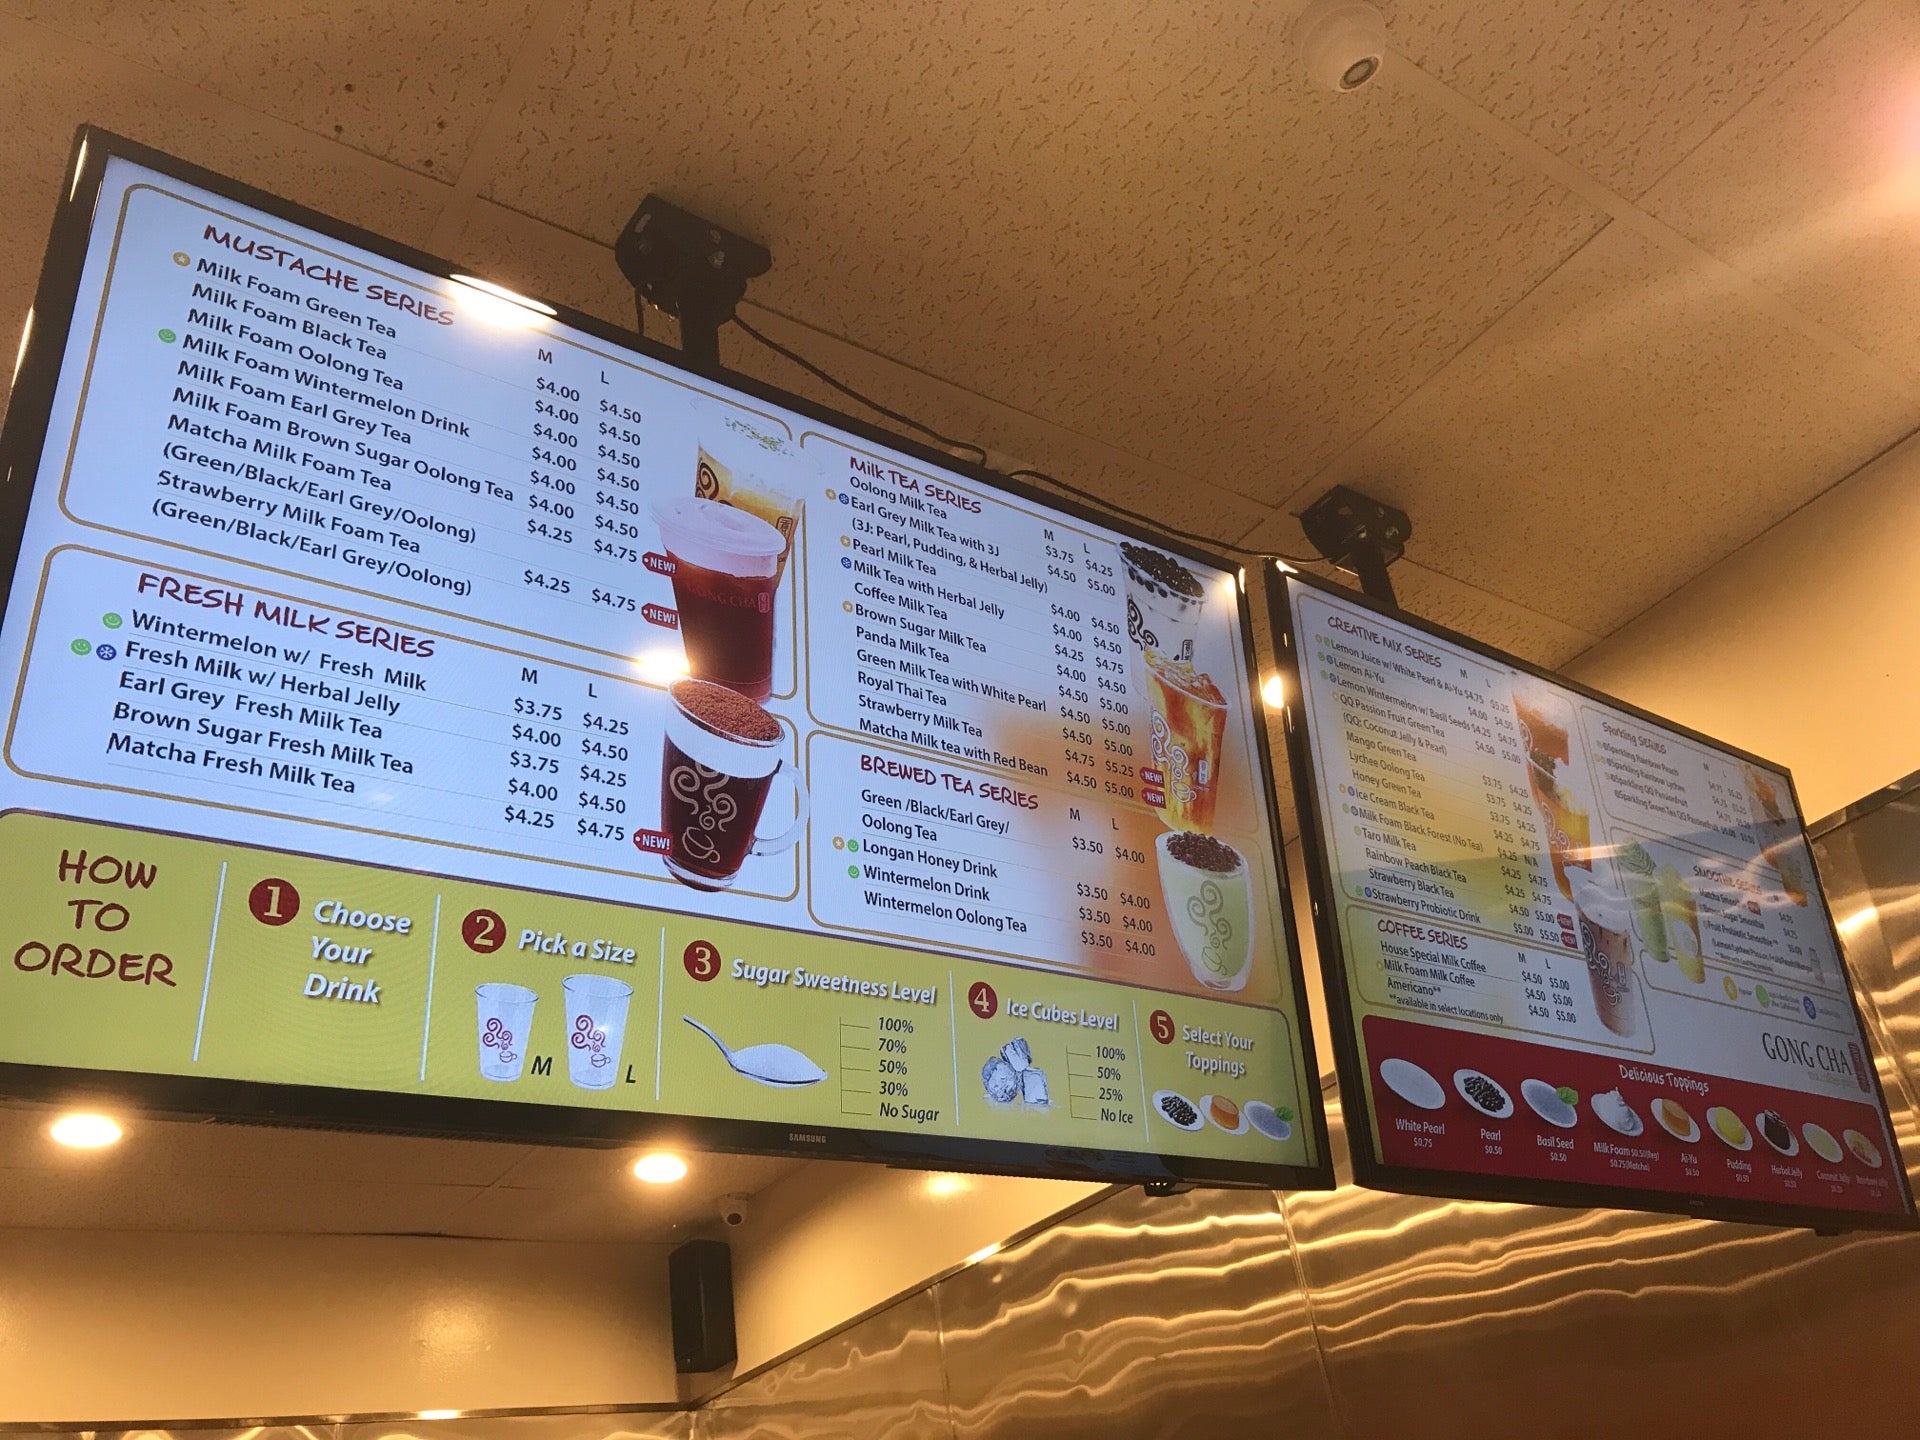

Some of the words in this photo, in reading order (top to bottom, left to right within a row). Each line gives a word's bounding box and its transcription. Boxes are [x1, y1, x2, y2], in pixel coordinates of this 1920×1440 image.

[202, 223, 360, 294] MUSTACHE
[364, 284, 454, 326] SERIES
[195, 256, 243, 286] Milk
[245, 273, 301, 306] Foam
[304, 296, 362, 328] Green
[365, 314, 397, 339] Tea
[536, 347, 553, 365] M
[599, 369, 610, 386] L
[181, 333, 230, 362] Milk
[233, 348, 290, 381] Foam
[293, 367, 417, 421] Wintermelon
[420, 409, 470, 438] Drink
[535, 375, 581, 403] $4.00
[598, 398, 642, 425] $4.50
[171, 385, 221, 414] Milk
[224, 400, 282, 432] Foam
[286, 419, 350, 453] Brown
[353, 440, 411, 470] Sugar
[412, 459, 481, 495] Oolong
[483, 479, 514, 502] Tea
[162, 441, 345, 506] (Green/Black/Earl
[348, 493, 477, 544] Grey/Oolong)
[848, 475, 897, 505] Oolong
[898, 491, 926, 513] Milk
[925, 501, 948, 520] Tea
[849, 455, 886, 482] Milk
[886, 468, 921, 495] TEA
[923, 483, 982, 515] SERIES
[850, 494, 876, 516] Earl
[876, 505, 907, 528] Grey
[908, 515, 936, 536] Milk
[934, 524, 958, 544] Tea
[958, 534, 986, 553] with
[986, 542, 1000, 558] 3J
[649, 556, 677, 574] NEW!
[851, 516, 875, 536] (3J:
[875, 524, 911, 549] Pearl,
[911, 536, 967, 568] Pudding,
[967, 555, 979, 571] &
[978, 559, 1018, 583] Herbal
[1018, 573, 1049, 594] Jelly)
[1044, 543, 1075, 565] $3.75
[1084, 557, 1114, 578] $4.25
[136, 571, 245, 617] FRESH
[252, 599, 331, 636] MILK
[334, 619, 436, 658] SERIES
[131, 608, 277, 659] Wintermelon
[282, 647, 311, 666] w/
[318, 652, 374, 681] Fresh
[383, 667, 427, 692] Milk
[1326, 615, 1382, 646] CREATIVE
[1381, 635, 1404, 655] MIX
[1403, 643, 1443, 669] SERIES
[520, 666, 538, 685] M
[587, 681, 598, 699] L
[513, 695, 563, 722] $3.75
[581, 711, 630, 736] $4.25
[859, 753, 938, 786] BREWED
[939, 772, 975, 797] TEA
[978, 781, 1039, 811] SERIES
[1143, 769, 1164, 784] NEW!
[503, 803, 555, 829] $4.25
[576, 817, 625, 842] $4.75
[860, 788, 903, 811] Green
[974, 813, 1010, 836] Grey/
[641, 833, 671, 851] NEW!
[1360, 825, 1382, 843] Taro
[1381, 831, 1403, 849] Milk
[1399, 836, 1418, 852] Tea
[57, 848, 158, 890] HOW
[862, 837, 915, 862] Longan
[916, 848, 961, 874] Honey
[961, 857, 998, 879] Drink
[1367, 866, 1417, 893] Strawberry
[1415, 878, 1441, 896] Black
[1437, 884, 1455, 899] Tea
[66, 898, 131, 933] TO
[263, 884, 283, 918] 1
[306, 899, 412, 934] Choose
[862, 889, 954, 920] Wintermelon
[954, 906, 1004, 933] Oolong
[1004, 915, 1028, 933] Tea
[1370, 886, 1421, 913] Strawberry
[1419, 898, 1459, 919] Probiotic
[1457, 907, 1482, 924] Drink
[472, 914, 495, 947] 2
[514, 927, 569, 955] Pick
[569, 940, 588, 958] a
[588, 938, 636, 964] Size
[1080, 928, 1114, 950] $3.50
[1124, 938, 1156, 957] $4.00
[1376, 918, 1427, 942] COFFEE
[1426, 927, 1469, 951] SERIES
[13, 940, 178, 988] ORDER
[311, 933, 373, 969] Your
[694, 945, 712, 976] 3
[1379, 939, 1417, 961] House
[1413, 949, 1441, 965] Special
[1439, 951, 1461, 969] Milk
[1458, 956, 1487, 975] Coffee
[302, 969, 382, 1004] Drink
[727, 957, 791, 987] Sugar
[791, 965, 892, 1006] Sweetness
[889, 979, 936, 1010] Level
[1520, 969, 1544, 986] $4.50
[1547, 975, 1571, 992] $5.00
[973, 986, 990, 1013] 4
[1002, 996, 1029, 1023] Ice
[1029, 1000, 1078, 1025] Cubes
[1078, 1007, 1121, 1036] Level
[878, 1015, 914, 1035] 100%
[1155, 1014, 1170, 1040] 5
[1178, 1023, 1222, 1052] Select
[1218, 1029, 1254, 1055] Your
[877, 1036, 908, 1055] 70%
[1095, 1044, 1127, 1062] 100%
[1184, 1046, 1246, 1078] Toppings
[1760, 1031, 1816, 1069] GONG
[1814, 1043, 1853, 1076] CHA
[877, 1058, 908, 1076] 50%
[1617, 1063, 1666, 1086] Delicious
[1664, 1071, 1710, 1098] Toppings
[878, 1079, 909, 1098] 30%
[1097, 1086, 1124, 1103] 25%
[878, 1100, 900, 1119] No
[900, 1103, 940, 1125] Sugar
[1099, 1106, 1117, 1123] No
[1117, 1108, 1134, 1125] Ice
[1394, 1116, 1423, 1133] White
[1421, 1120, 1446, 1136] Pearl
[788, 1132, 826, 1144] SAMSUNG
[1479, 1127, 1502, 1142] Pearl
[1535, 1133, 1556, 1148] Basil
[1554, 1135, 1575, 1150] Seed
